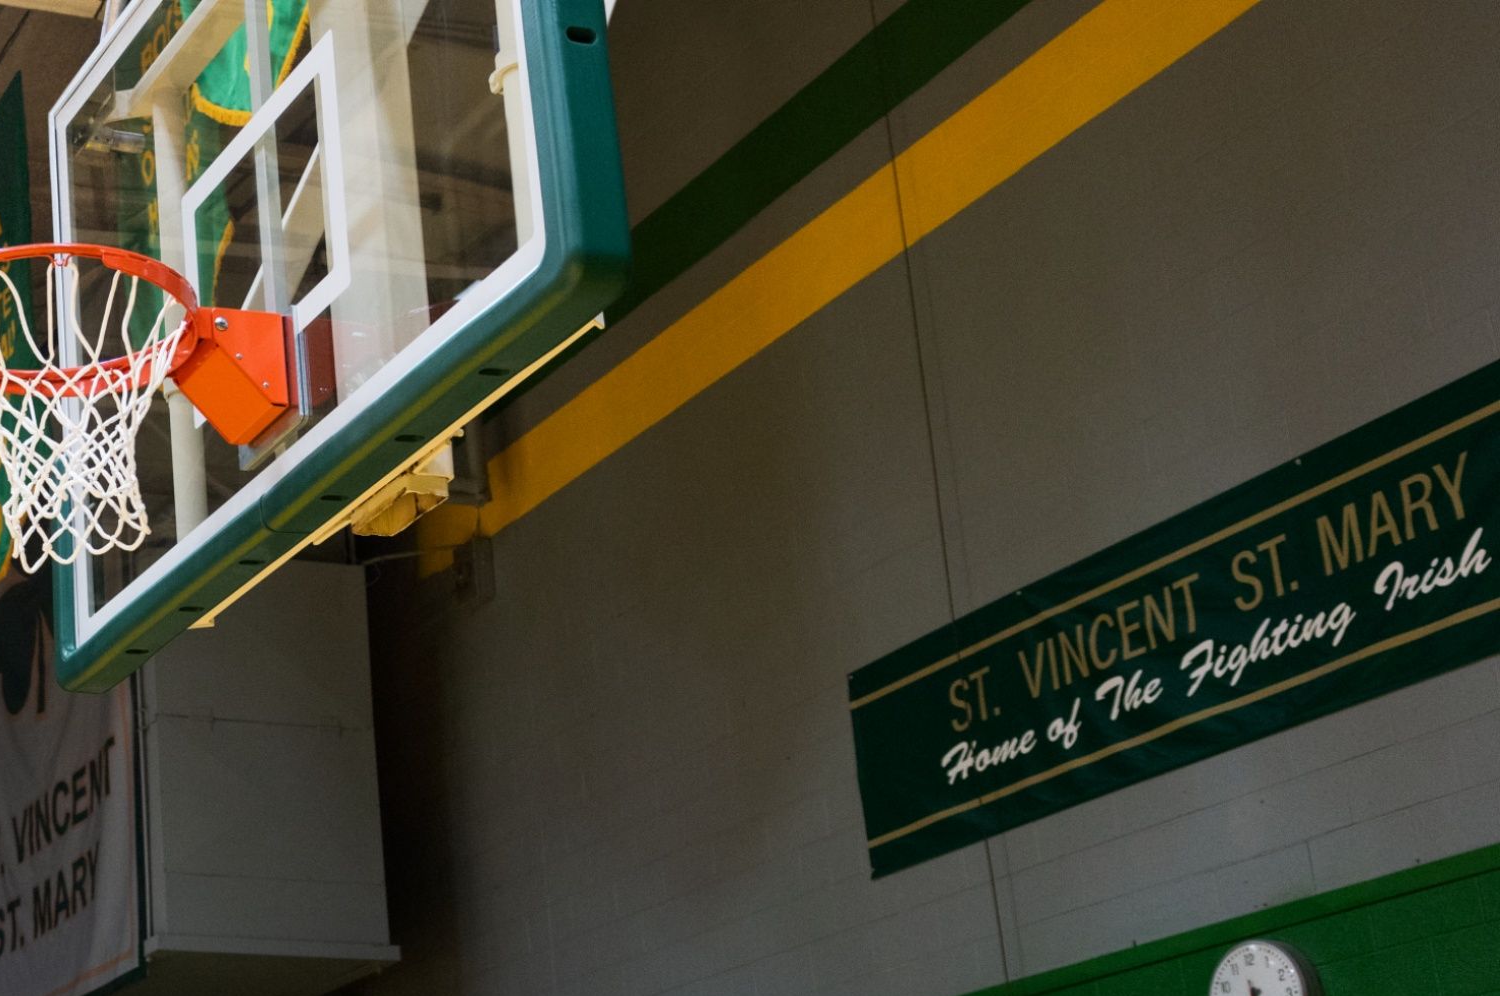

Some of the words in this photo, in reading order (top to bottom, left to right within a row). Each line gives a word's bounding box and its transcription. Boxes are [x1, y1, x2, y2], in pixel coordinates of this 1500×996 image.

[941, 740, 1037, 785] Home
[1047, 697, 1082, 749] of
[1095, 669, 1163, 721] The
[1180, 602, 1357, 698] Fighting
[1373, 527, 1493, 611] Irish
[950, 667, 1001, 732] ST.
[1018, 573, 1199, 698] VINCENT
[1231, 533, 1299, 611] ST.
[1315, 451, 1468, 577] MARY
[12, 736, 116, 865] VINCENT
[32, 842, 100, 939] MARY
